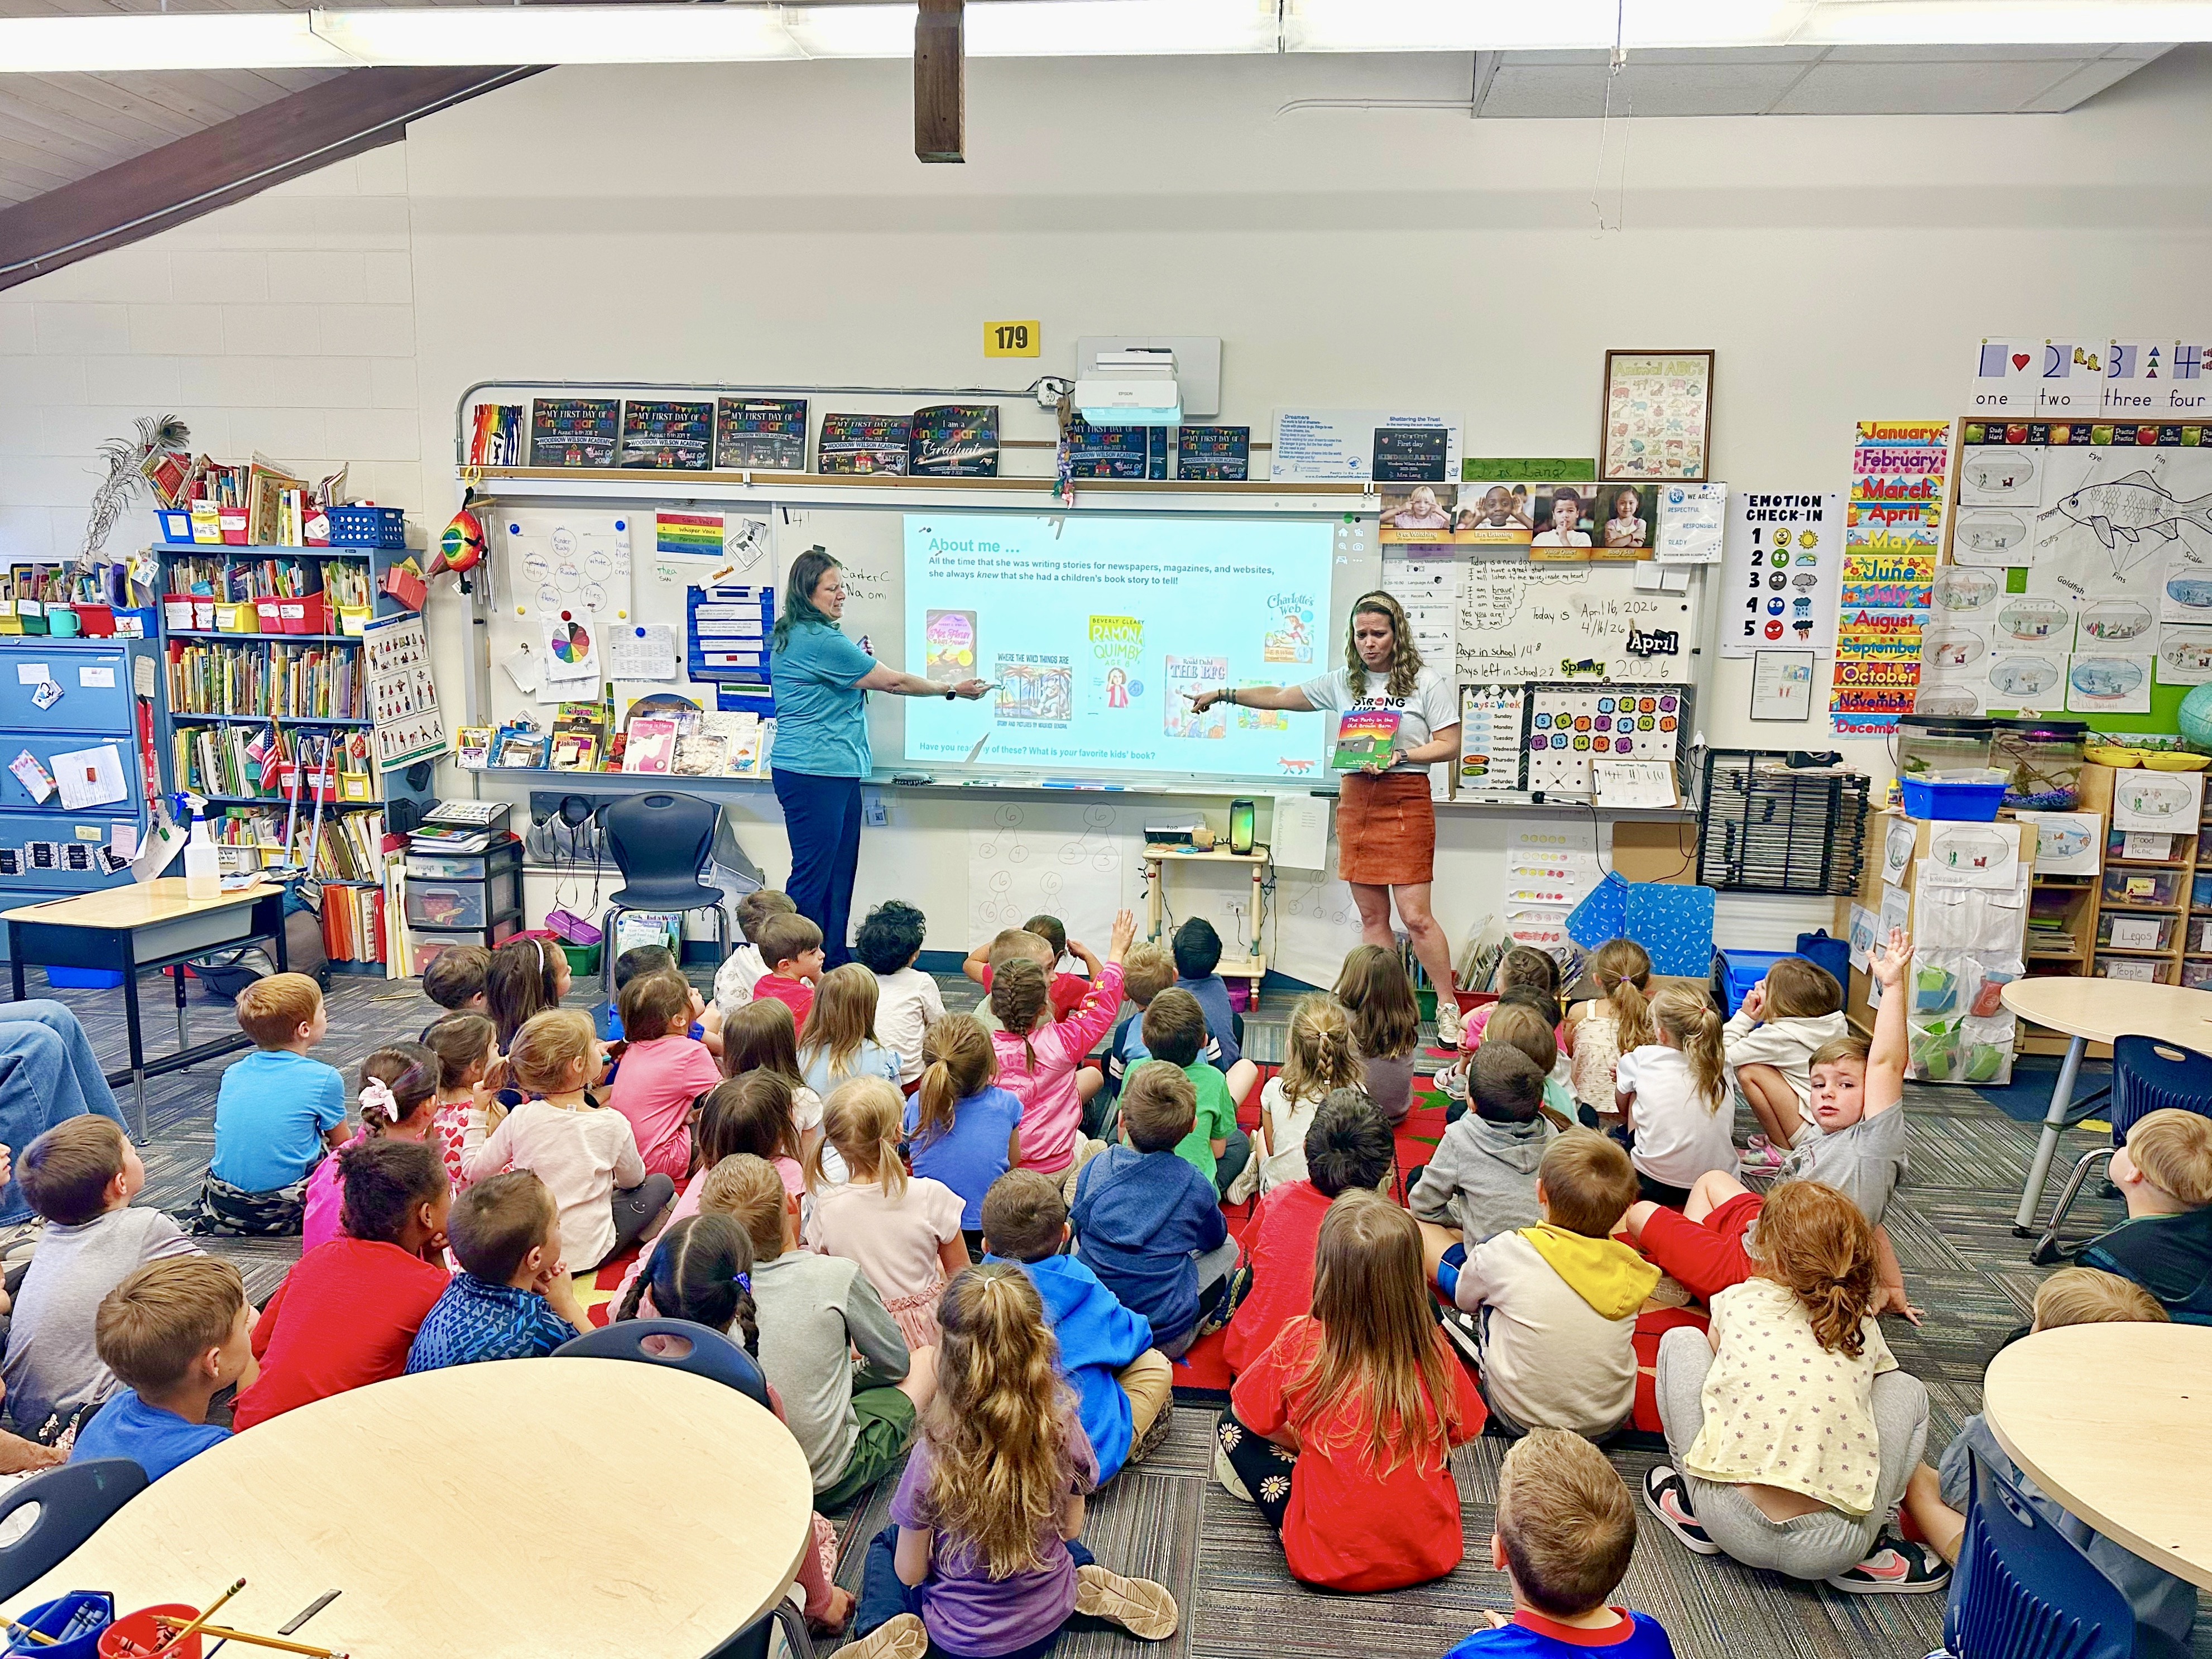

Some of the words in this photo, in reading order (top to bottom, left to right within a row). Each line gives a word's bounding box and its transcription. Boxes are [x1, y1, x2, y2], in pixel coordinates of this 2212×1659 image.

[995, 325, 1028, 349] 179
[2043, 345, 2061, 378] 2
[2107, 345, 2123, 378] 3
[2174, 346, 2201, 379] 4
[1976, 394, 2008, 405] one
[2040, 388, 2071, 405] two
[2104, 388, 2152, 406] three
[2169, 389, 2206, 407] four
[546, 410, 558, 419] MY
[560, 410, 581, 419] FIRST
[537, 418, 613, 433] Kindergarten
[1864, 422, 1940, 445] January
[911, 428, 997, 442] Kindergarten
[921, 442, 986, 456] Graduate
[2089, 451, 2103, 462] Eye
[1862, 449, 1939, 473] February
[2155, 454, 2166, 465] Fin
[1862, 478, 1932, 498] March
[1749, 495, 1822, 507] EMOTION
[1745, 509, 1823, 522] CHECK-IN
[1868, 504, 1920, 528] April
[1752, 528, 1761, 544] 1
[1869, 530, 1916, 554] May
[928, 538, 974, 552] About
[978, 541, 1000, 553] me
[1751, 549, 1763, 566] 2
[958, 557, 976, 565] time
[1032, 559, 1061, 570] writing
[1063, 561, 1091, 569] stories
[1108, 563, 1162, 573] newspapers,
[1163, 564, 1212, 574] magazines,
[1214, 565, 1231, 573] and
[1232, 565, 1275, 576] websites,
[1863, 559, 1916, 581] June
[946, 570, 975, 579] always
[1061, 573, 1102, 582] children's
[1104, 575, 1125, 583] book
[1127, 576, 1149, 585] story
[1163, 577, 1178, 585] tell!
[1749, 572, 1760, 588] 3
[2057, 575, 2085, 595] Goldfish
[2112, 571, 2126, 584] Fins
[1266, 592, 1314, 609] Charlotte's
[1865, 584, 1909, 607] July
[1279, 605, 1301, 615] Web
[1531, 607, 1554, 625] Today
[1561, 608, 1570, 620] is
[1581, 601, 1605, 618] April
[1624, 602, 1658, 613] 2026
[1746, 597, 1758, 613] 4
[1581, 621, 1625, 637] 4/16/26
[1744, 620, 1756, 636] 5
[1853, 610, 1915, 634] August
[1092, 625, 1145, 647] RAMONA
[1456, 642, 1476, 658] Days
[1479, 646, 1488, 656] in
[1491, 644, 1516, 658] school
[1629, 634, 1676, 655] April
[1841, 637, 1922, 659] September
[997, 653, 1015, 662] WHERE
[1016, 654, 1025, 663] THE
[1026, 655, 1038, 663] WILD
[1039, 655, 1058, 664] THINGS
[1170, 665, 1198, 679] THE
[1201, 666, 1226, 680] BFG
[1616, 660, 1669, 678] 2026
[1842, 666, 1917, 683] October
[1466, 701, 1489, 711] Days
[1496, 700, 1522, 709] Week
[1839, 692, 1914, 708] November
[941, 744, 955, 752] you
[1001, 745, 1027, 754] these?
[1029, 747, 1049, 755] What
[1059, 749, 1077, 758] your
[1079, 749, 1109, 757] favorite
[1131, 751, 1156, 760] book?
[2133, 833, 2155, 845] Food
[2131, 844, 2153, 855] Picnic
[2122, 929, 2152, 946] Legos
[2115, 963, 2143, 978] People
